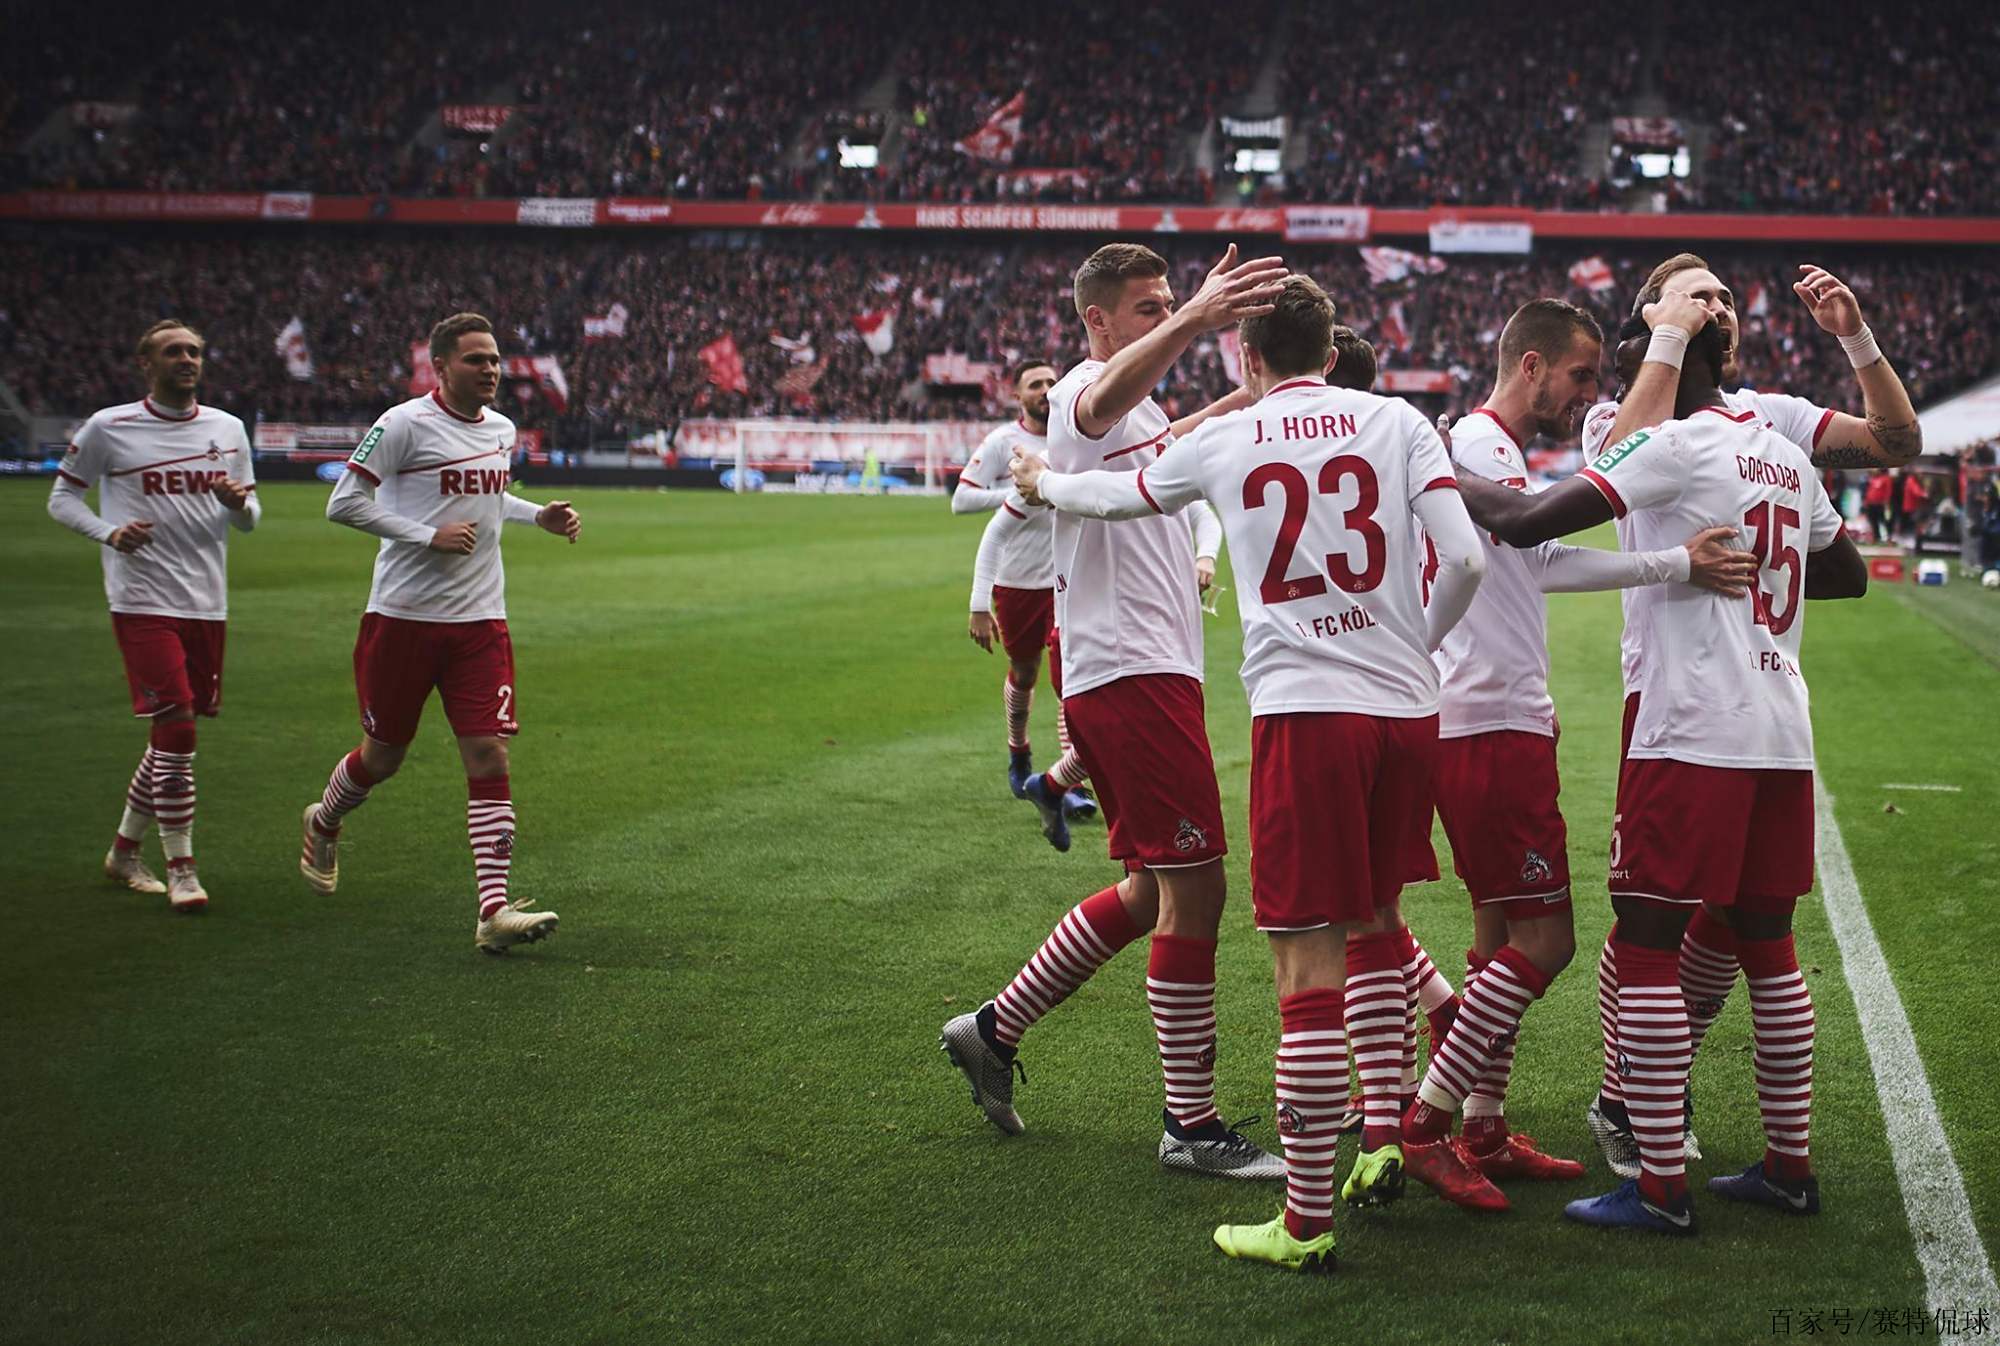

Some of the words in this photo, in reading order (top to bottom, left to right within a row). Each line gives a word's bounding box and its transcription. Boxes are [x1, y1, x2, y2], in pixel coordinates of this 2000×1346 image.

[916, 206, 958, 228] HANS
[355, 429, 382, 461] DEVK
[1254, 420, 1272, 444] J.
[1283, 413, 1358, 441] HORN
[1597, 432, 1642, 469] DEVK
[1736, 454, 1802, 495] CORDOBA
[1242, 454, 1387, 605] 23
[1744, 500, 1802, 635] 15
[1312, 615, 1338, 639] FC
[1339, 605, 1377, 633] KÖL
[1760, 651, 1781, 671] FC
[497, 684, 512, 721] 2
